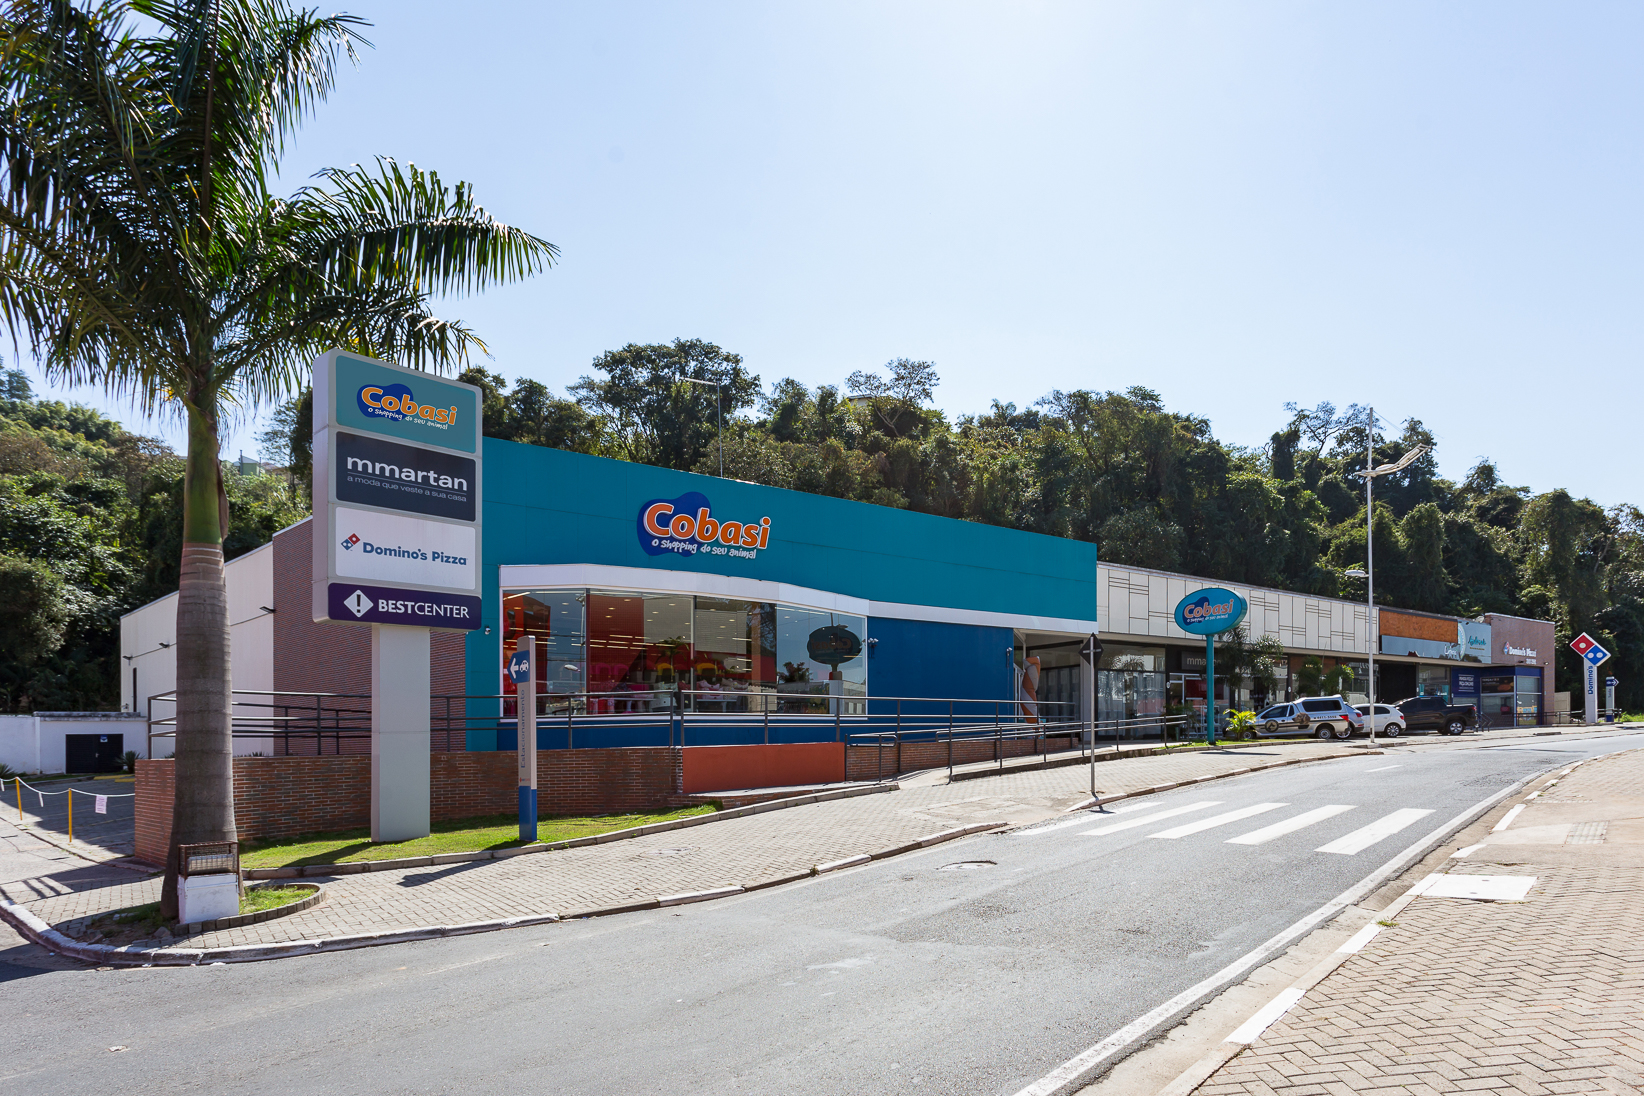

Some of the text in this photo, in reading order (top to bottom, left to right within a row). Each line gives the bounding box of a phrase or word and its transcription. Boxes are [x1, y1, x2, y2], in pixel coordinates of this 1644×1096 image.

[361, 387, 457, 425] Cobasi
[426, 421, 449, 430] animal
[347, 456, 467, 491] mmartan
[347, 475, 354, 483] a
[354, 476, 381, 487] moda
[382, 481, 399, 490] que
[400, 485, 424, 495] veste
[431, 491, 447, 499] sua
[447, 494, 467, 502] casa
[643, 502, 771, 549] Cobasi
[363, 541, 467, 566] Domino's Pizza
[651, 538, 659, 546] o
[700, 543, 711, 553] do
[711, 546, 728, 555] seu
[728, 548, 757, 559] animal
[378, 599, 470, 619] BESTCENTER
[1184, 599, 1234, 618] Cobasi
